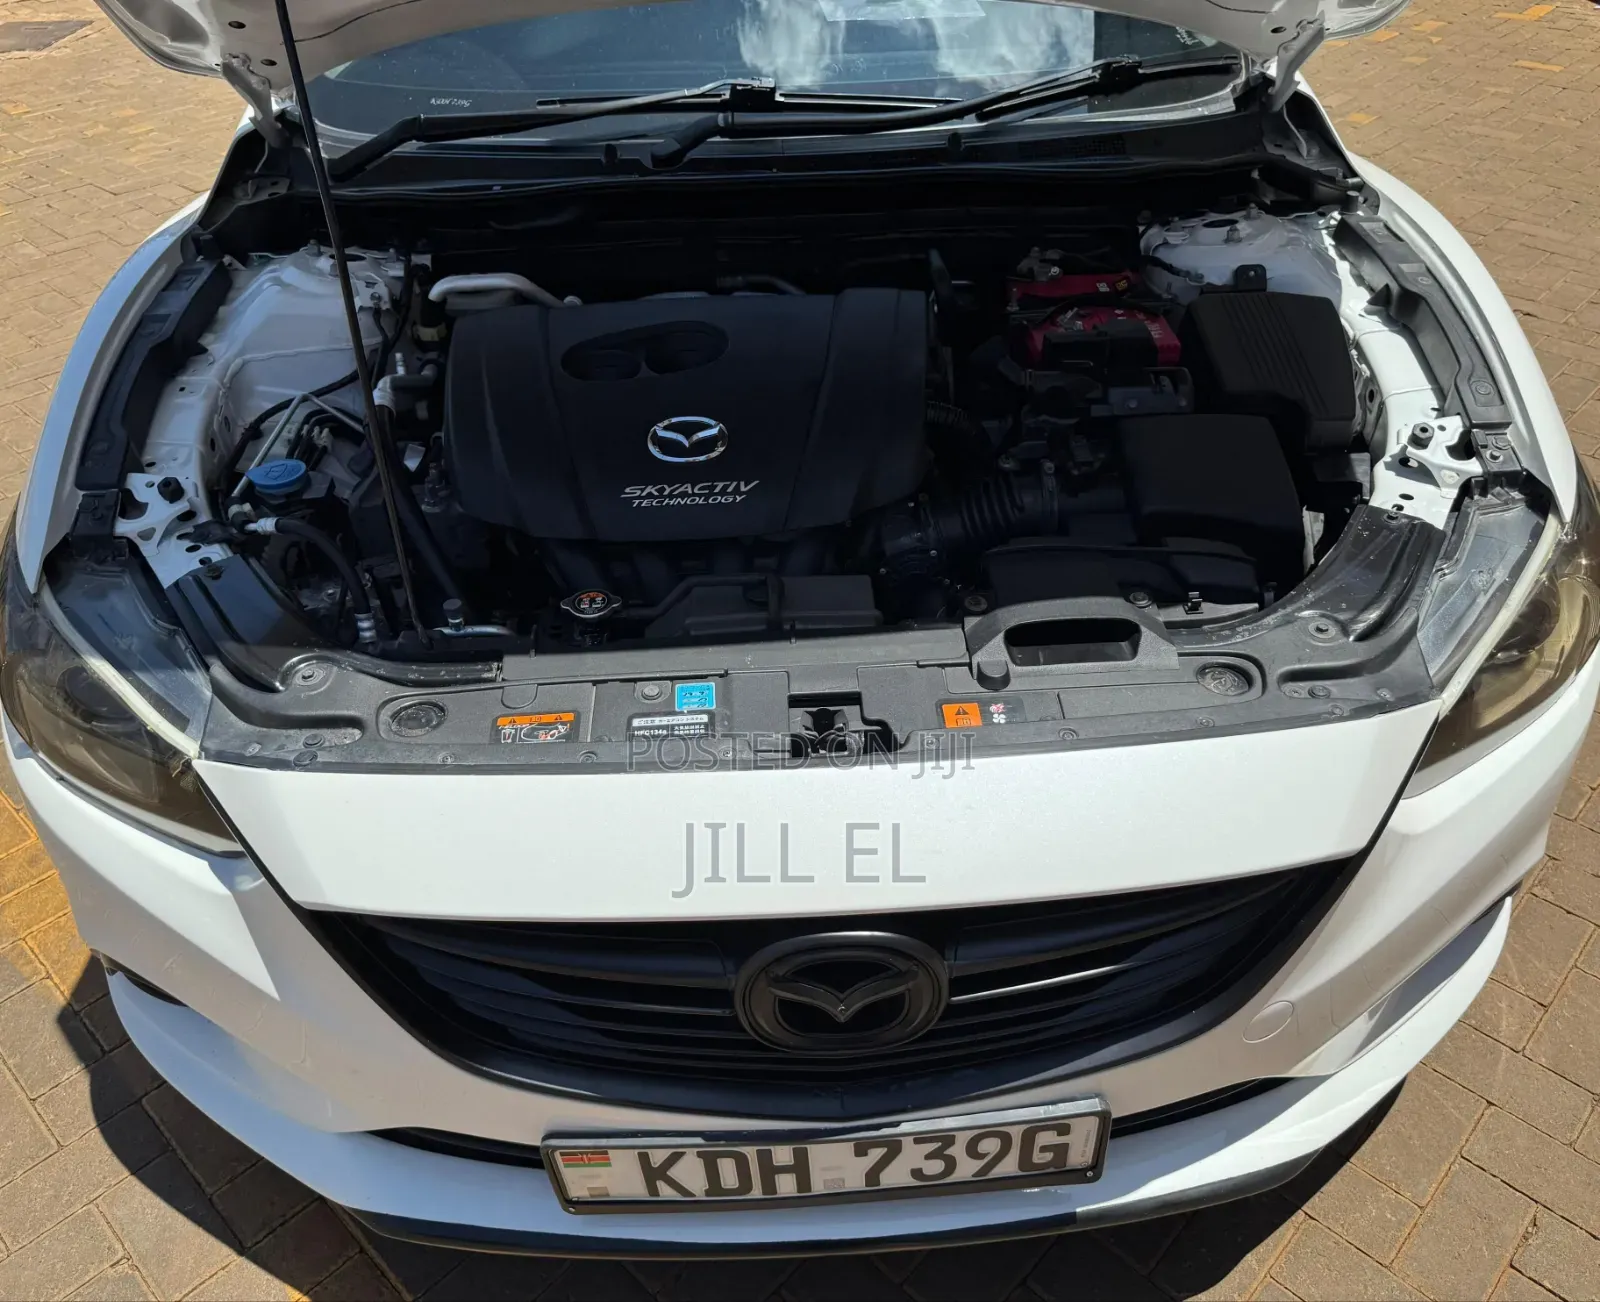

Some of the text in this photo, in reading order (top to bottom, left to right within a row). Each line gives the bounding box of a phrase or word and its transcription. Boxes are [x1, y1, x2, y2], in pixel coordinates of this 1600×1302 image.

[620, 480, 760, 498] SKYACTIV
[632, 495, 747, 508] TECHNOLOGY
[636, 1146, 813, 1198] KDH
[853, 1122, 1072, 1188] 739G
